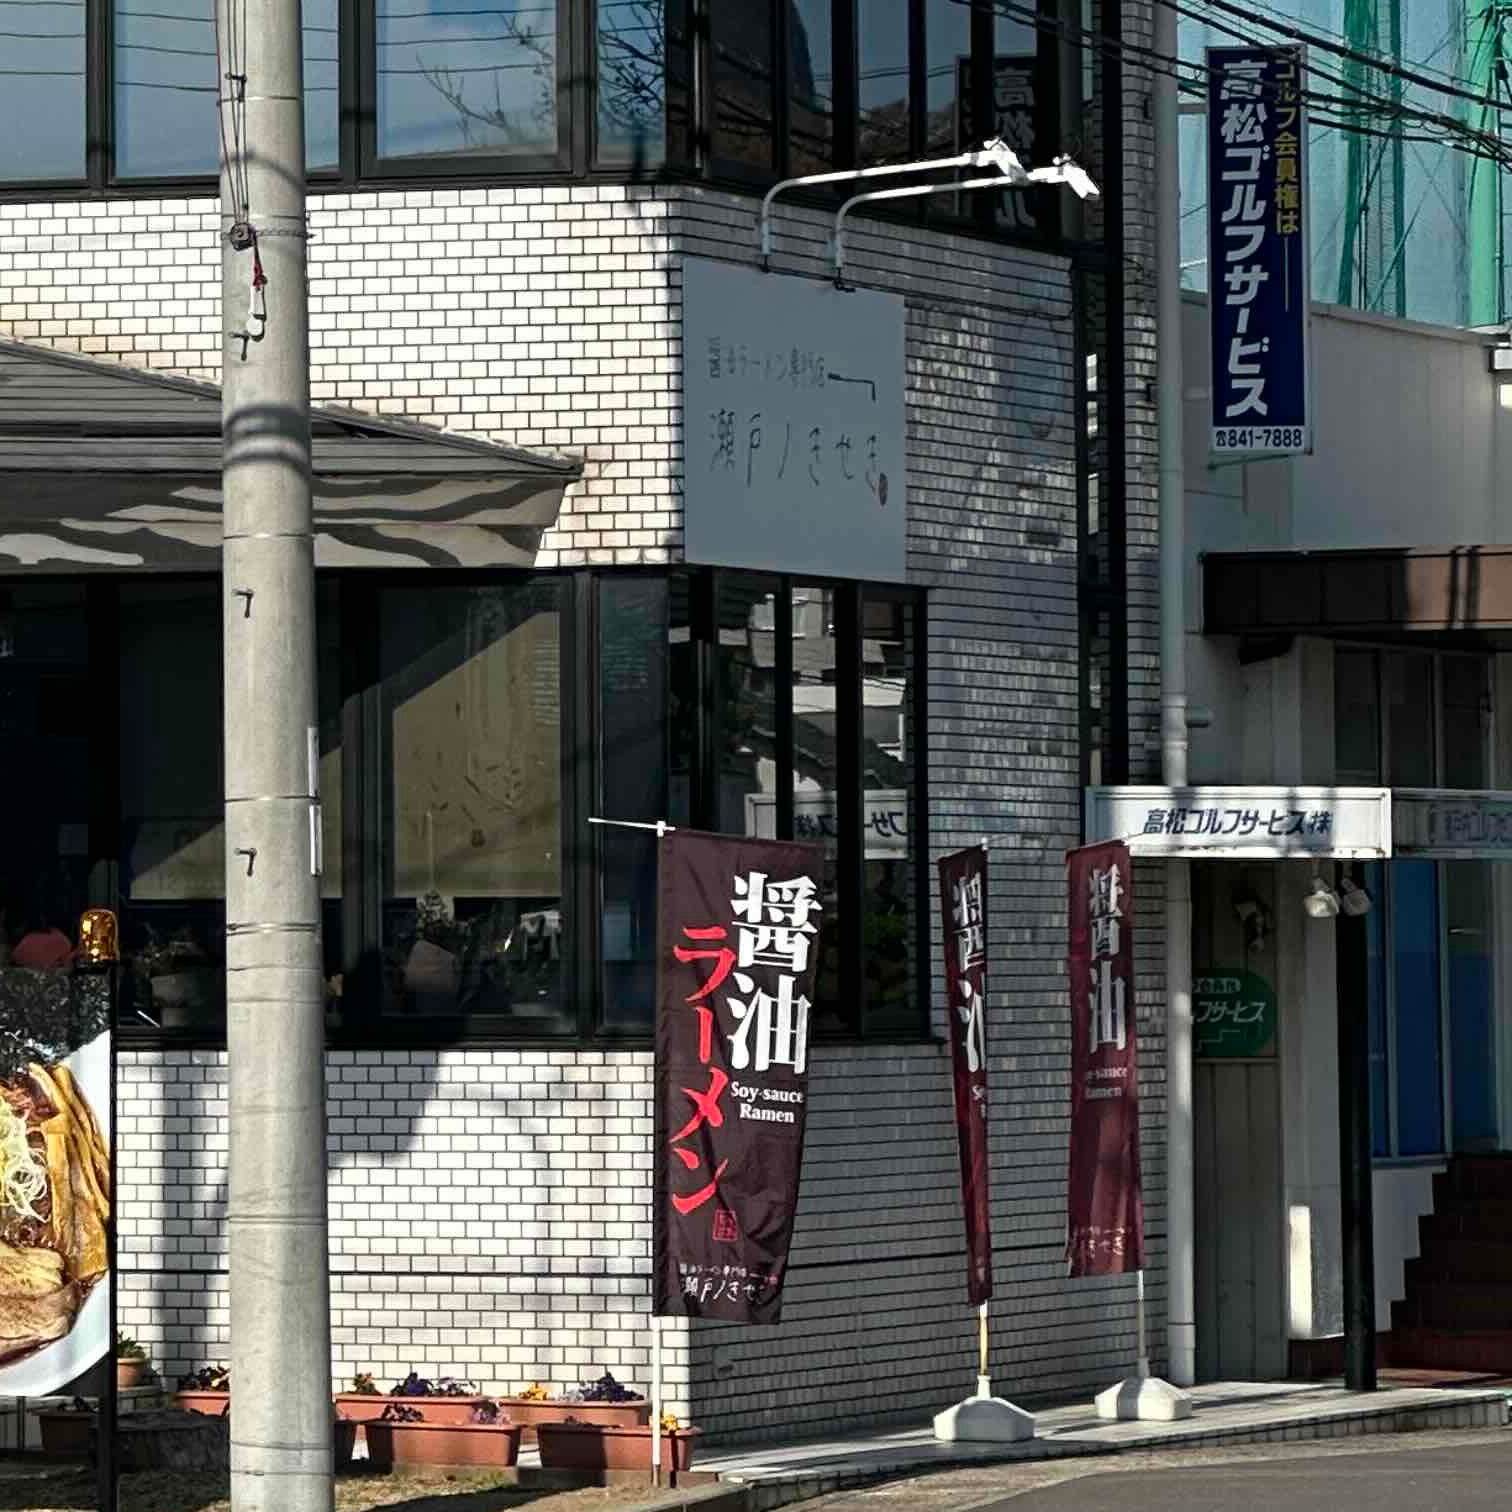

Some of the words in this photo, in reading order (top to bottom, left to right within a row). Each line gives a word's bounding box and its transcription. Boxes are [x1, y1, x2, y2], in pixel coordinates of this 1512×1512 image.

[1219, 59, 1270, 417] 高松ゴルフサービス
[1228, 428, 1302, 448] 841-7888
[728, 871, 821, 1074] 醤油
[670, 926, 736, 1215] ラーメン
[730, 1081, 804, 1103] Soy-sauce
[739, 1103, 795, 1123] Ramen
